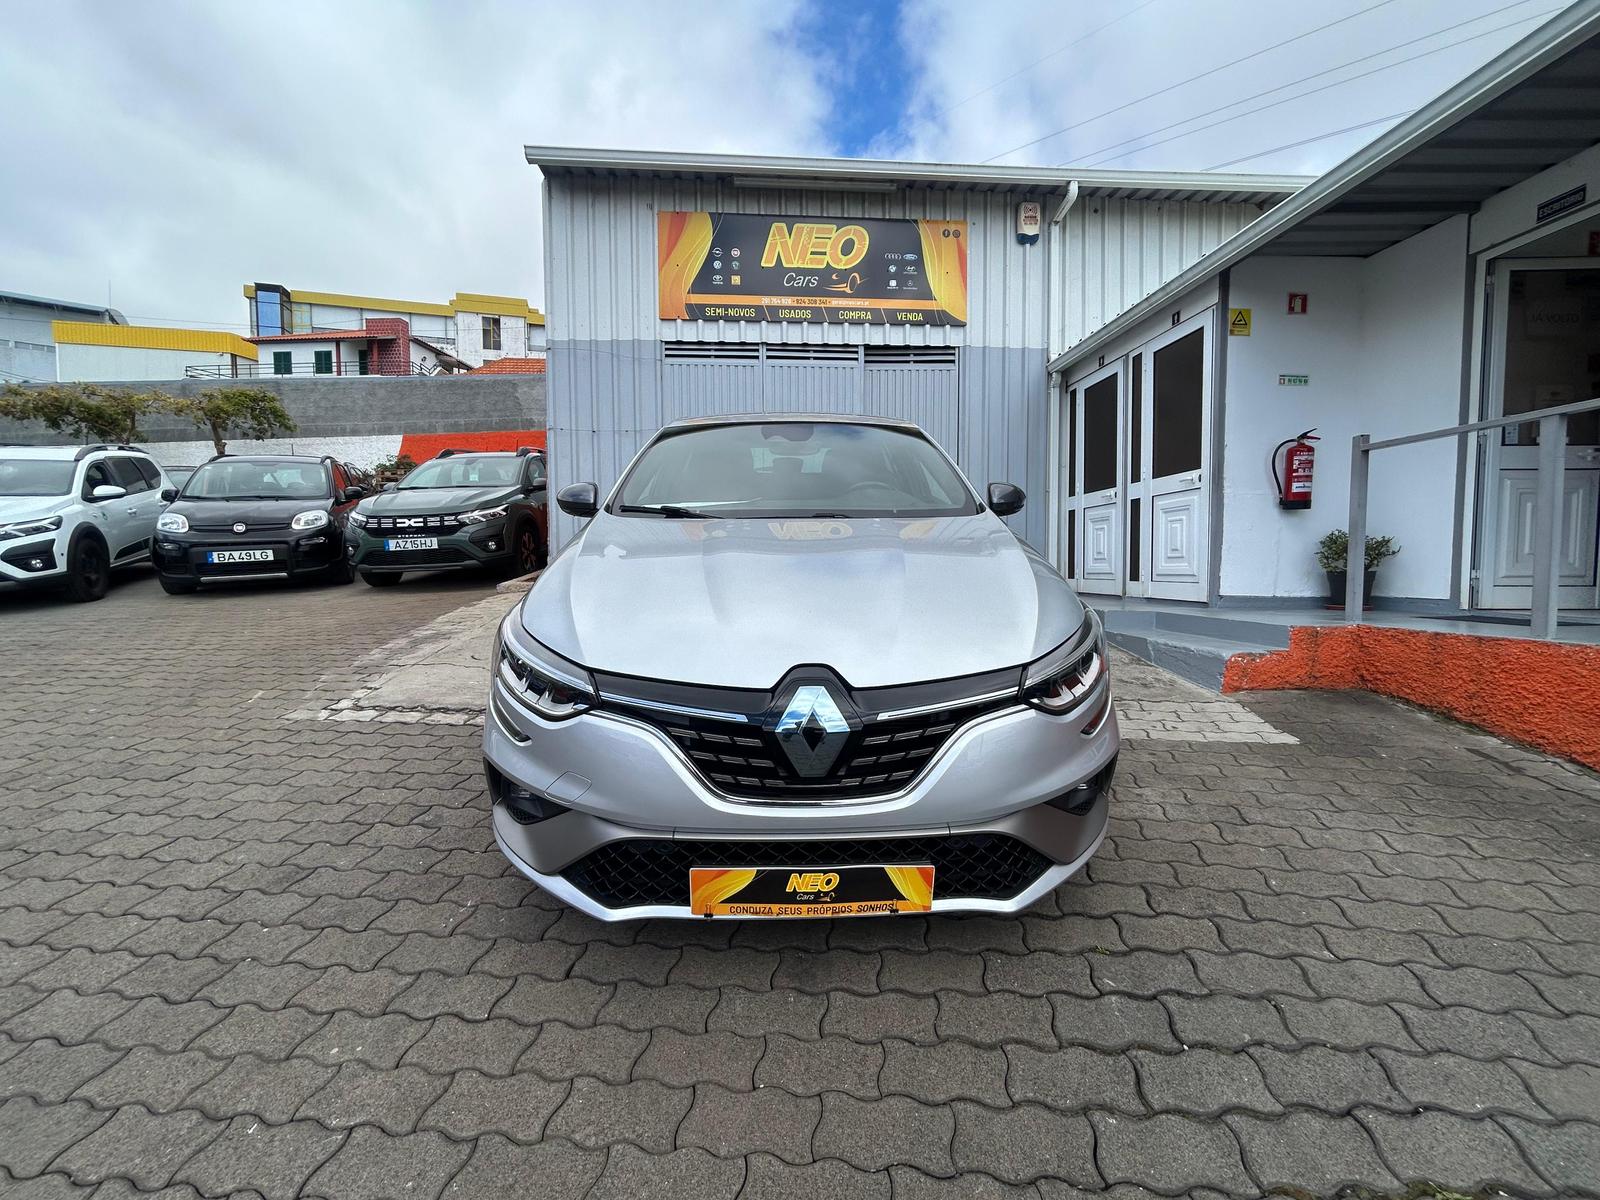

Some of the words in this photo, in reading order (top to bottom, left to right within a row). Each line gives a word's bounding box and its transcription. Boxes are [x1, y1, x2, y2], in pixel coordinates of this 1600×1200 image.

[761, 222, 870, 270] NEO
[783, 272, 819, 288] Cars
[705, 307, 756, 317] SEMI-NOVOS
[779, 309, 812, 319] USADOS
[838, 310, 872, 320] COMPRA
[896, 312, 924, 321] VENDA
[786, 872, 840, 892] NEO
[796, 893, 815, 901] Cars
[730, 905, 773, 916] CONDUZA
[778, 906, 803, 916] SEUS
[806, 904, 853, 916] PRÓPRIOS
[856, 903, 894, 913] SONHOS
